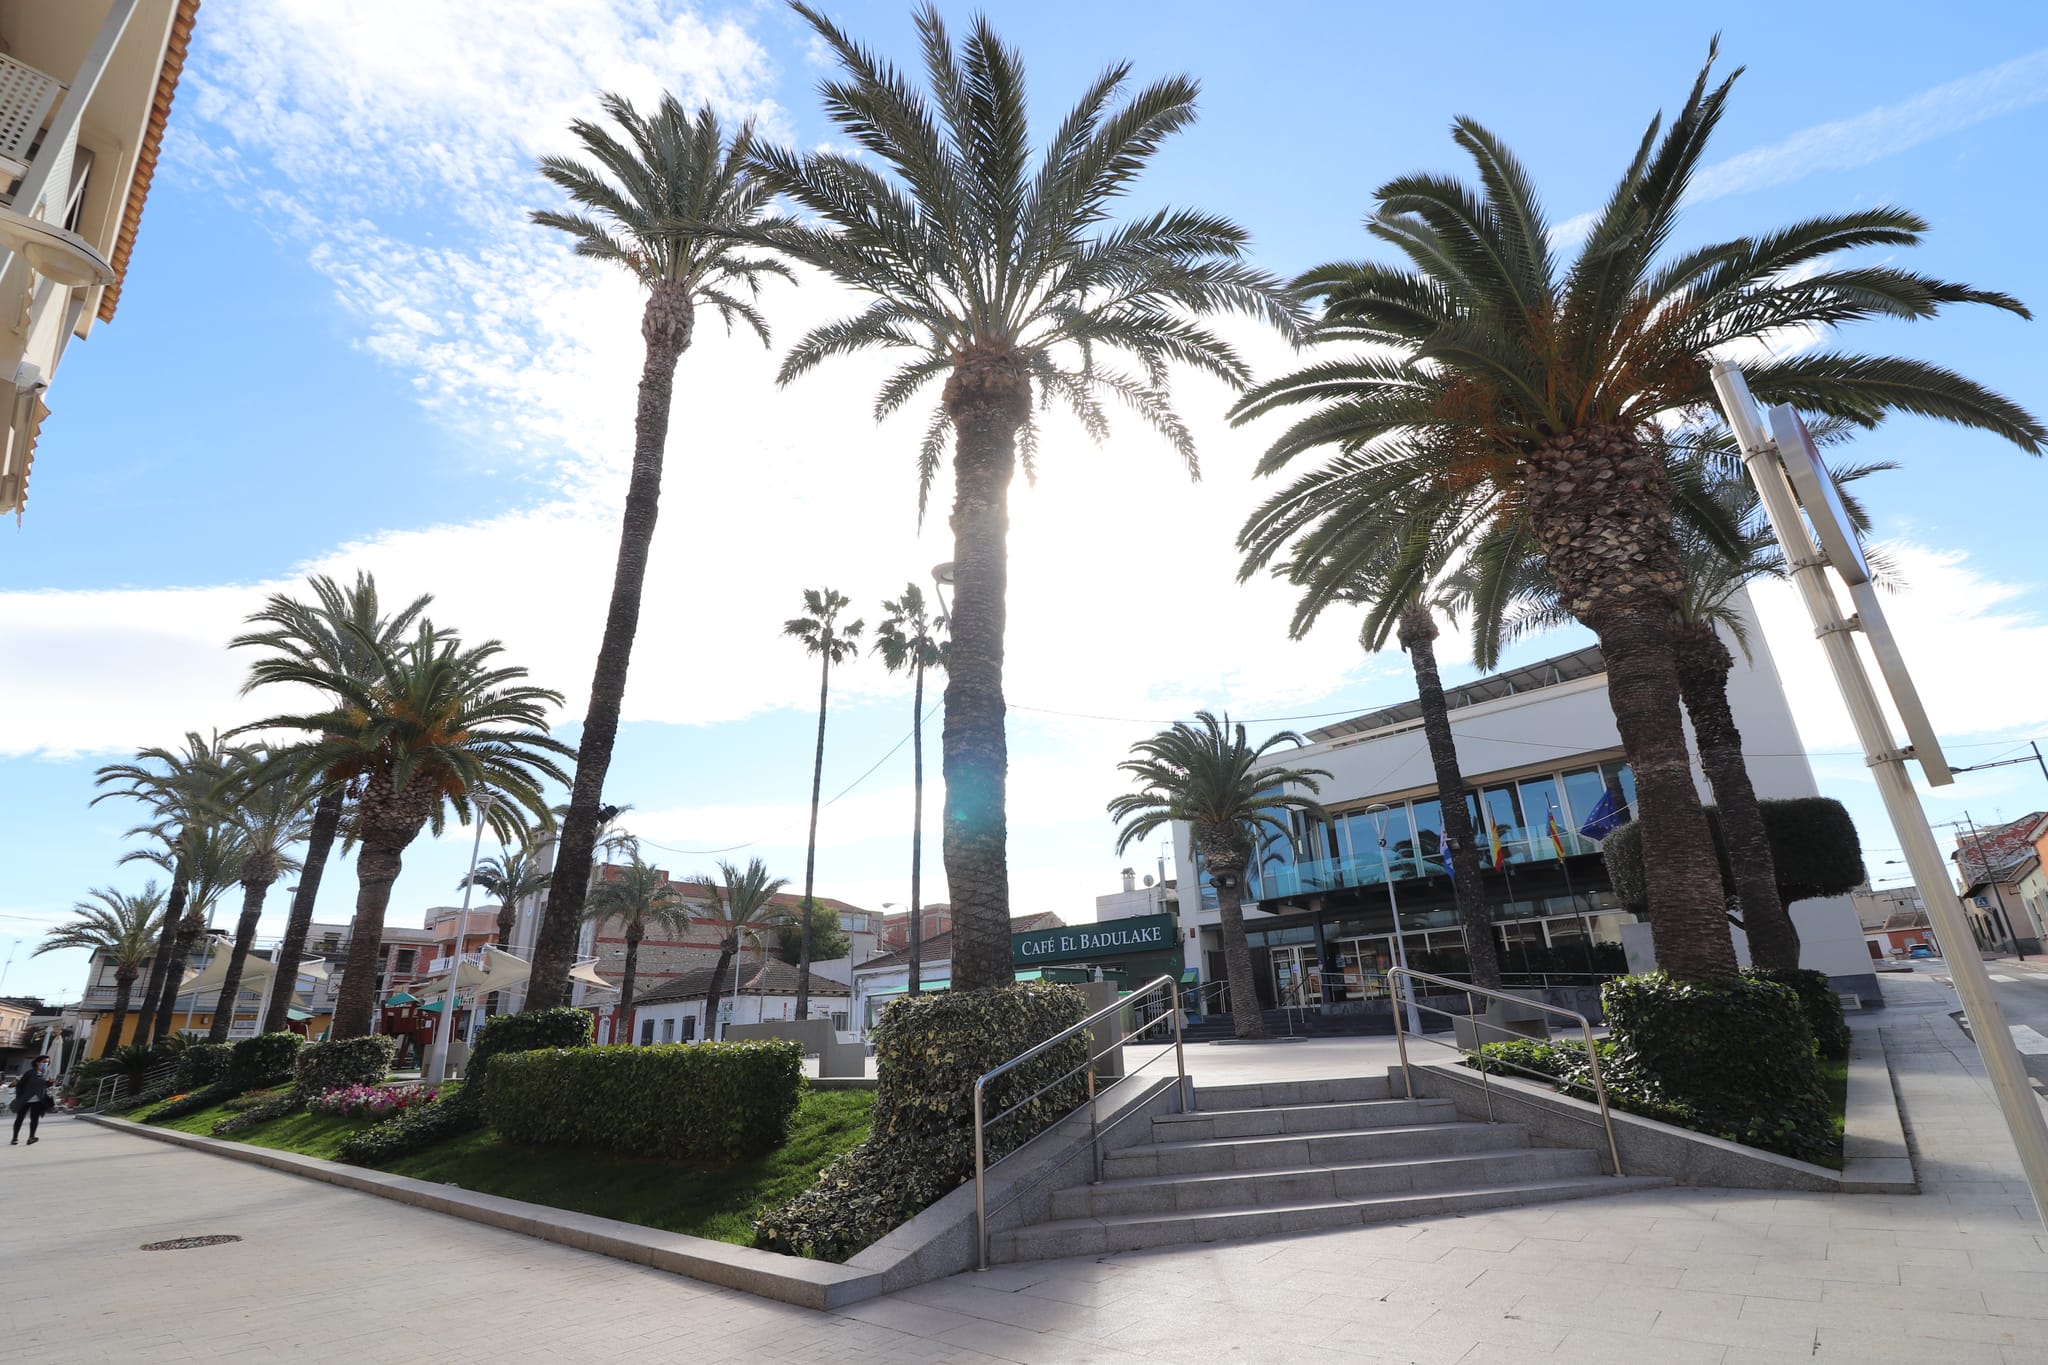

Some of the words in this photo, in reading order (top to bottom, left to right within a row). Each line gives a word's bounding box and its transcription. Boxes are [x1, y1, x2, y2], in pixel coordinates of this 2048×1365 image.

[1021, 936, 1056, 956] CAFÉ
[1060, 936, 1078, 952] EL
[1080, 926, 1162, 950] BADULAKE
